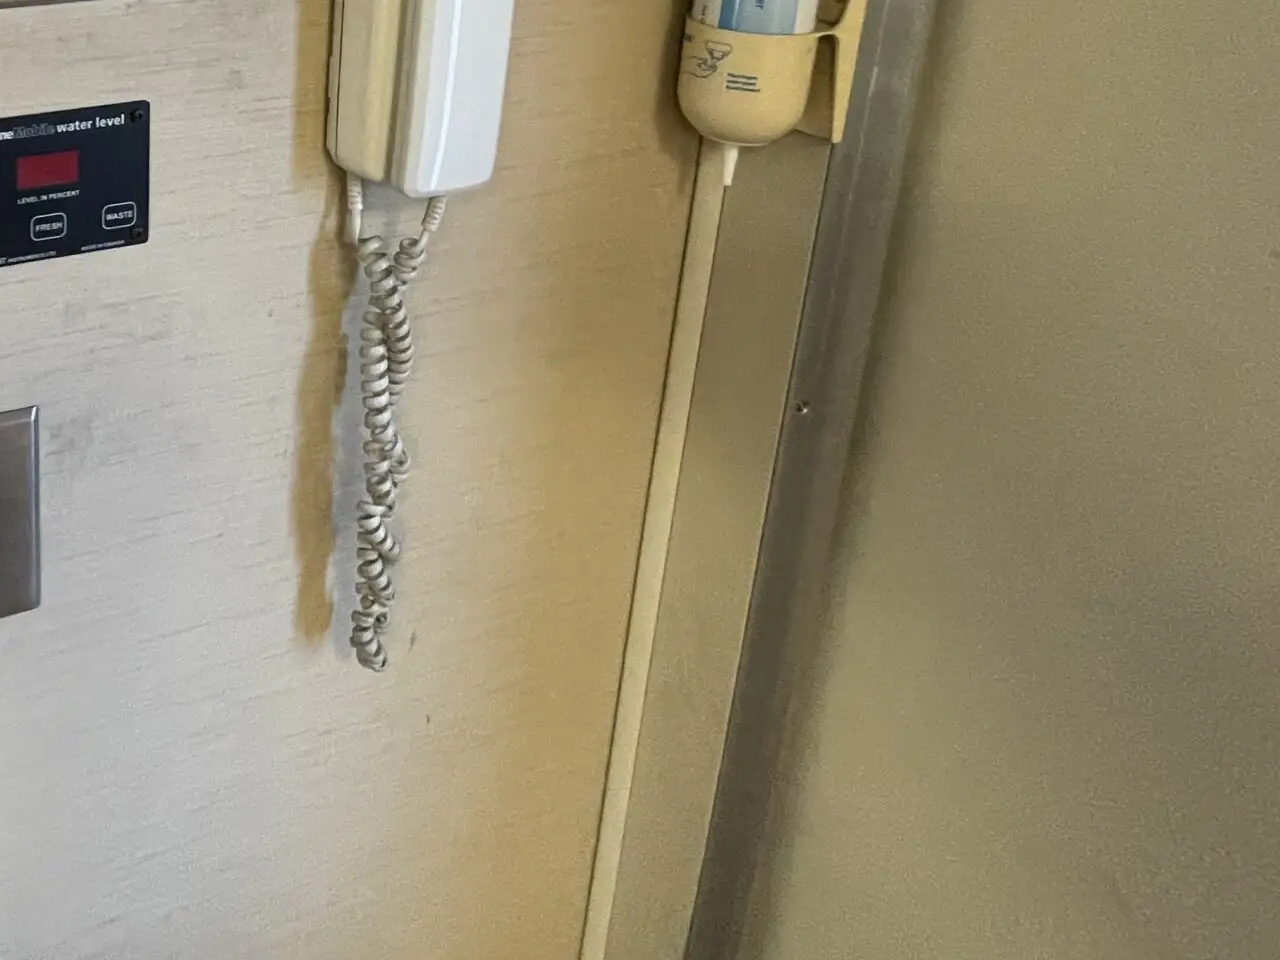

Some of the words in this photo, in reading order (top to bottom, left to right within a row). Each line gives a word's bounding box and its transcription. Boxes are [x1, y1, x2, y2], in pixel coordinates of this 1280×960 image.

[56, 119, 92, 134] water
[95, 114, 125, 128] level
[17, 195, 39, 205] LEVEL
[48, 190, 80, 200] PERCENT
[106, 210, 133, 221] WASTE
[35, 222, 63, 232] FRESH
